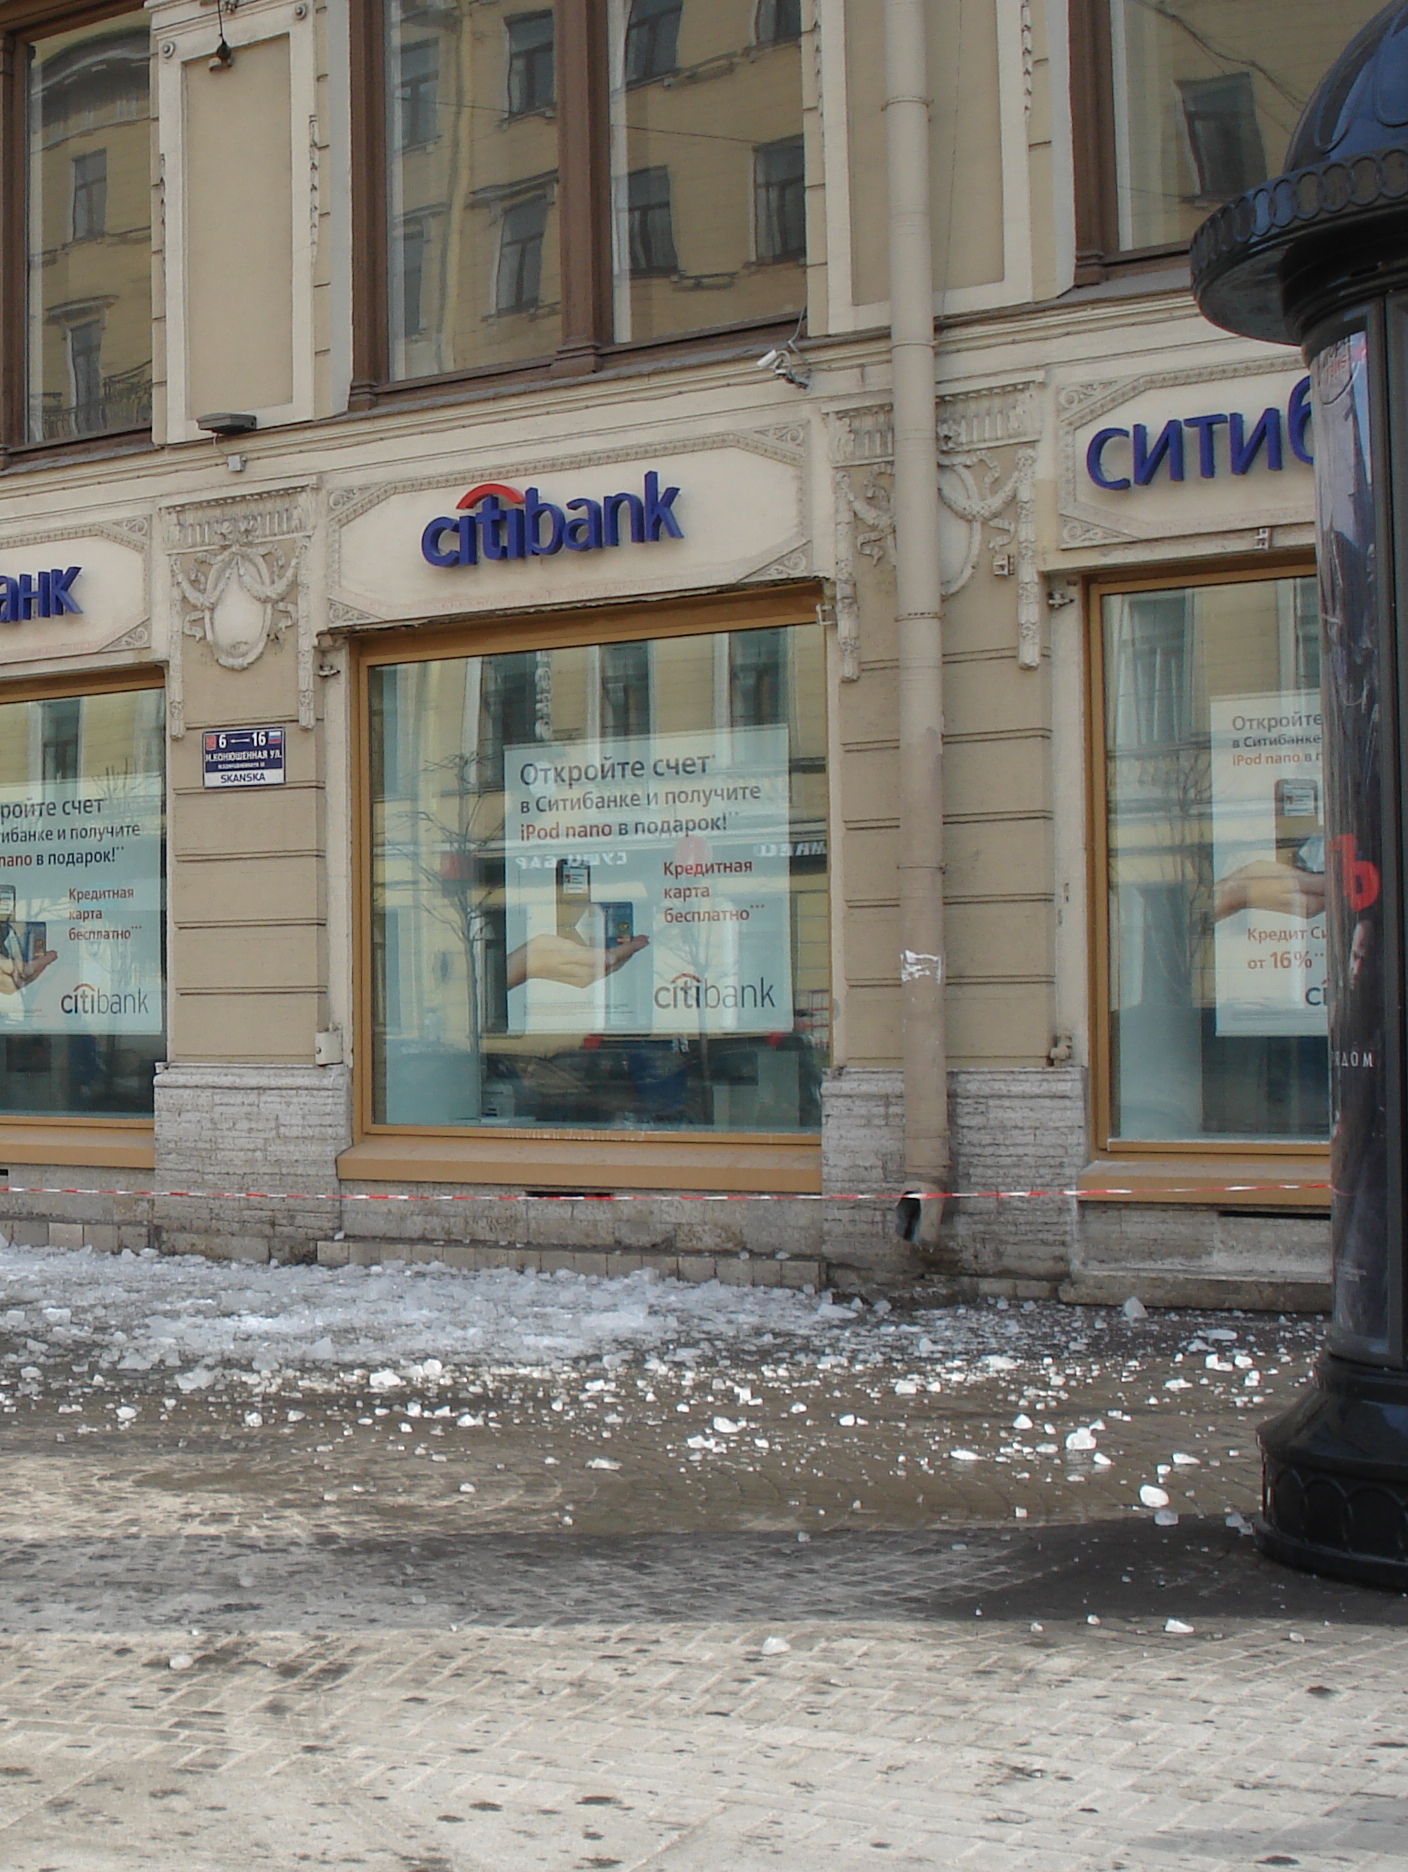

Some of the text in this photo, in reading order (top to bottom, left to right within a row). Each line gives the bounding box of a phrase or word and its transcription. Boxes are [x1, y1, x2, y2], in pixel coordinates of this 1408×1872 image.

[421, 470, 685, 568] citibank
[1232, 711, 1323, 732] Откройте
[218, 731, 266, 749] 6 16
[1243, 734, 1322, 748] Ситибанке
[1233, 753, 1261, 766] iPod
[1265, 753, 1300, 765] nano
[220, 772, 266, 784] SKANSKA
[520, 756, 645, 788] Откройте
[520, 784, 762, 814] в Ситибанке и получите
[57, 829, 67, 841] и
[70, 823, 141, 842] получите
[520, 822, 560, 842] iPod
[565, 822, 613, 839] nano
[618, 822, 628, 837] в
[36, 854, 44, 866] в
[663, 859, 753, 881] Кредитная
[68, 887, 134, 903] Кредитная
[663, 885, 711, 902] карта
[68, 908, 103, 923] карта
[1247, 928, 1308, 944] Кредит
[1247, 959, 1266, 970] от
[61, 983, 150, 1015] citibank
[654, 973, 776, 1010] citibank
